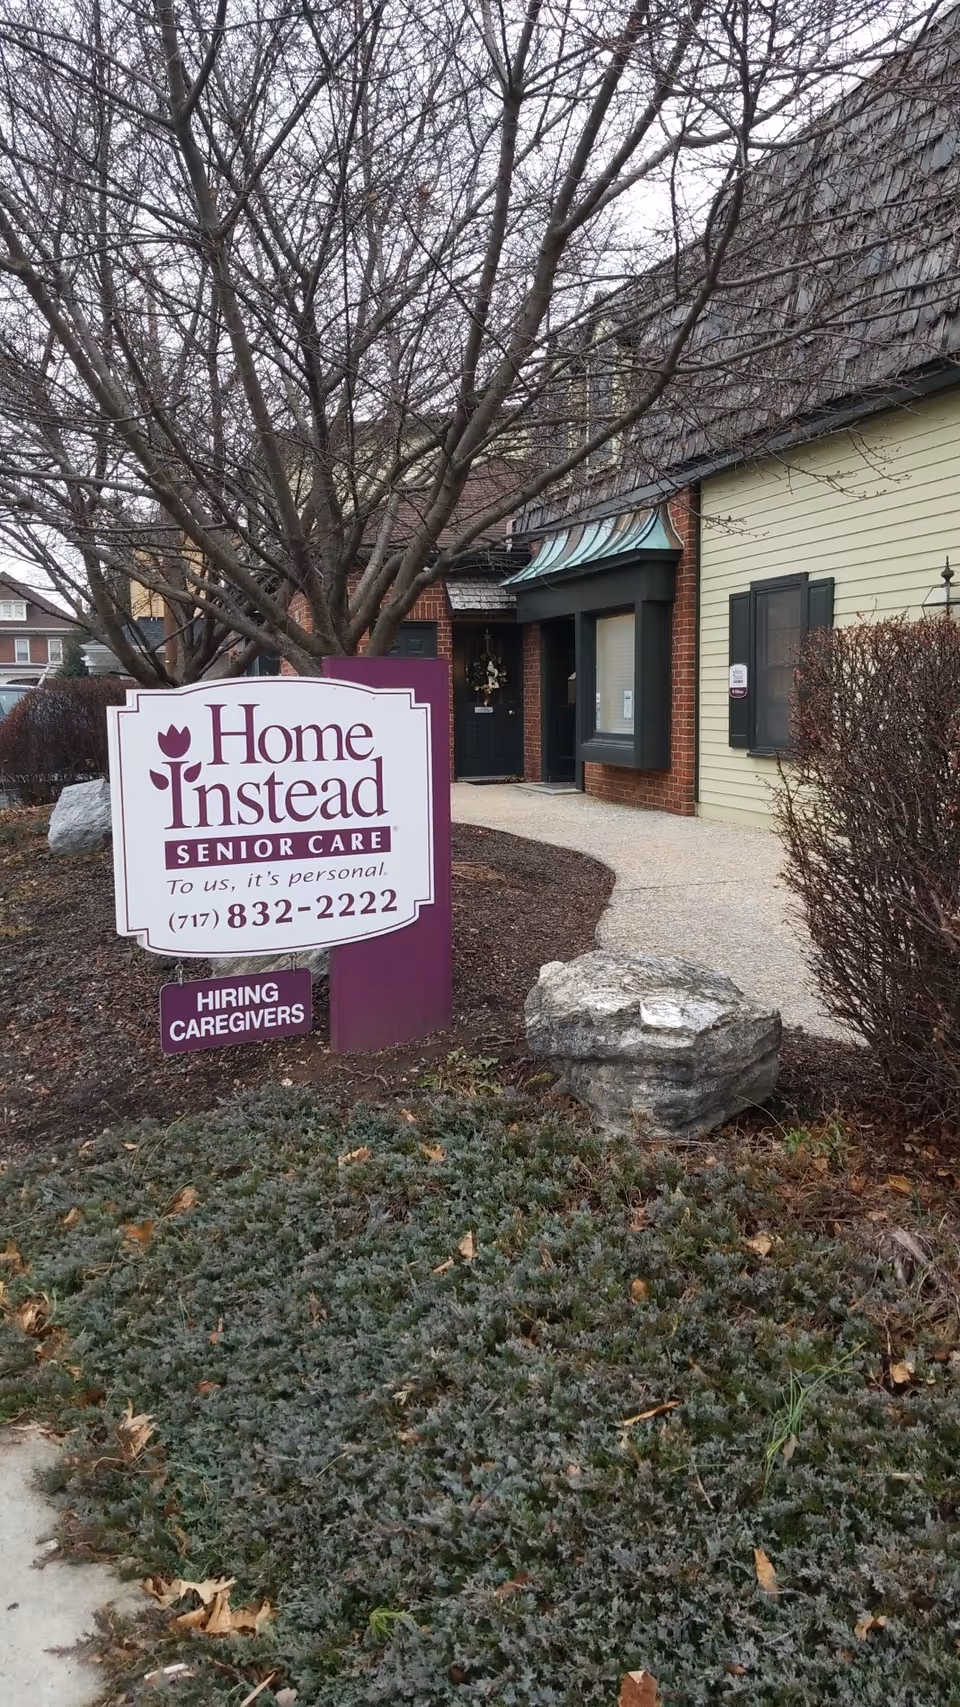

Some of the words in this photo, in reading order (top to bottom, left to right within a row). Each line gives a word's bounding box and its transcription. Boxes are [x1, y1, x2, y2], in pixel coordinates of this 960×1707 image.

[205, 704, 374, 765] Home
[162, 756, 389, 830] Instead
[177, 838, 294, 863] SENIOR
[308, 832, 382, 854] CARE
[167, 880, 193, 895] To
[204, 877, 235, 892] us,
[247, 871, 280, 887] it's
[168, 909, 219, 932] (717)
[227, 889, 397, 928] 832-2222
[197, 983, 279, 1012] HIRING
[169, 1004, 305, 1041] CAREGIVERS
